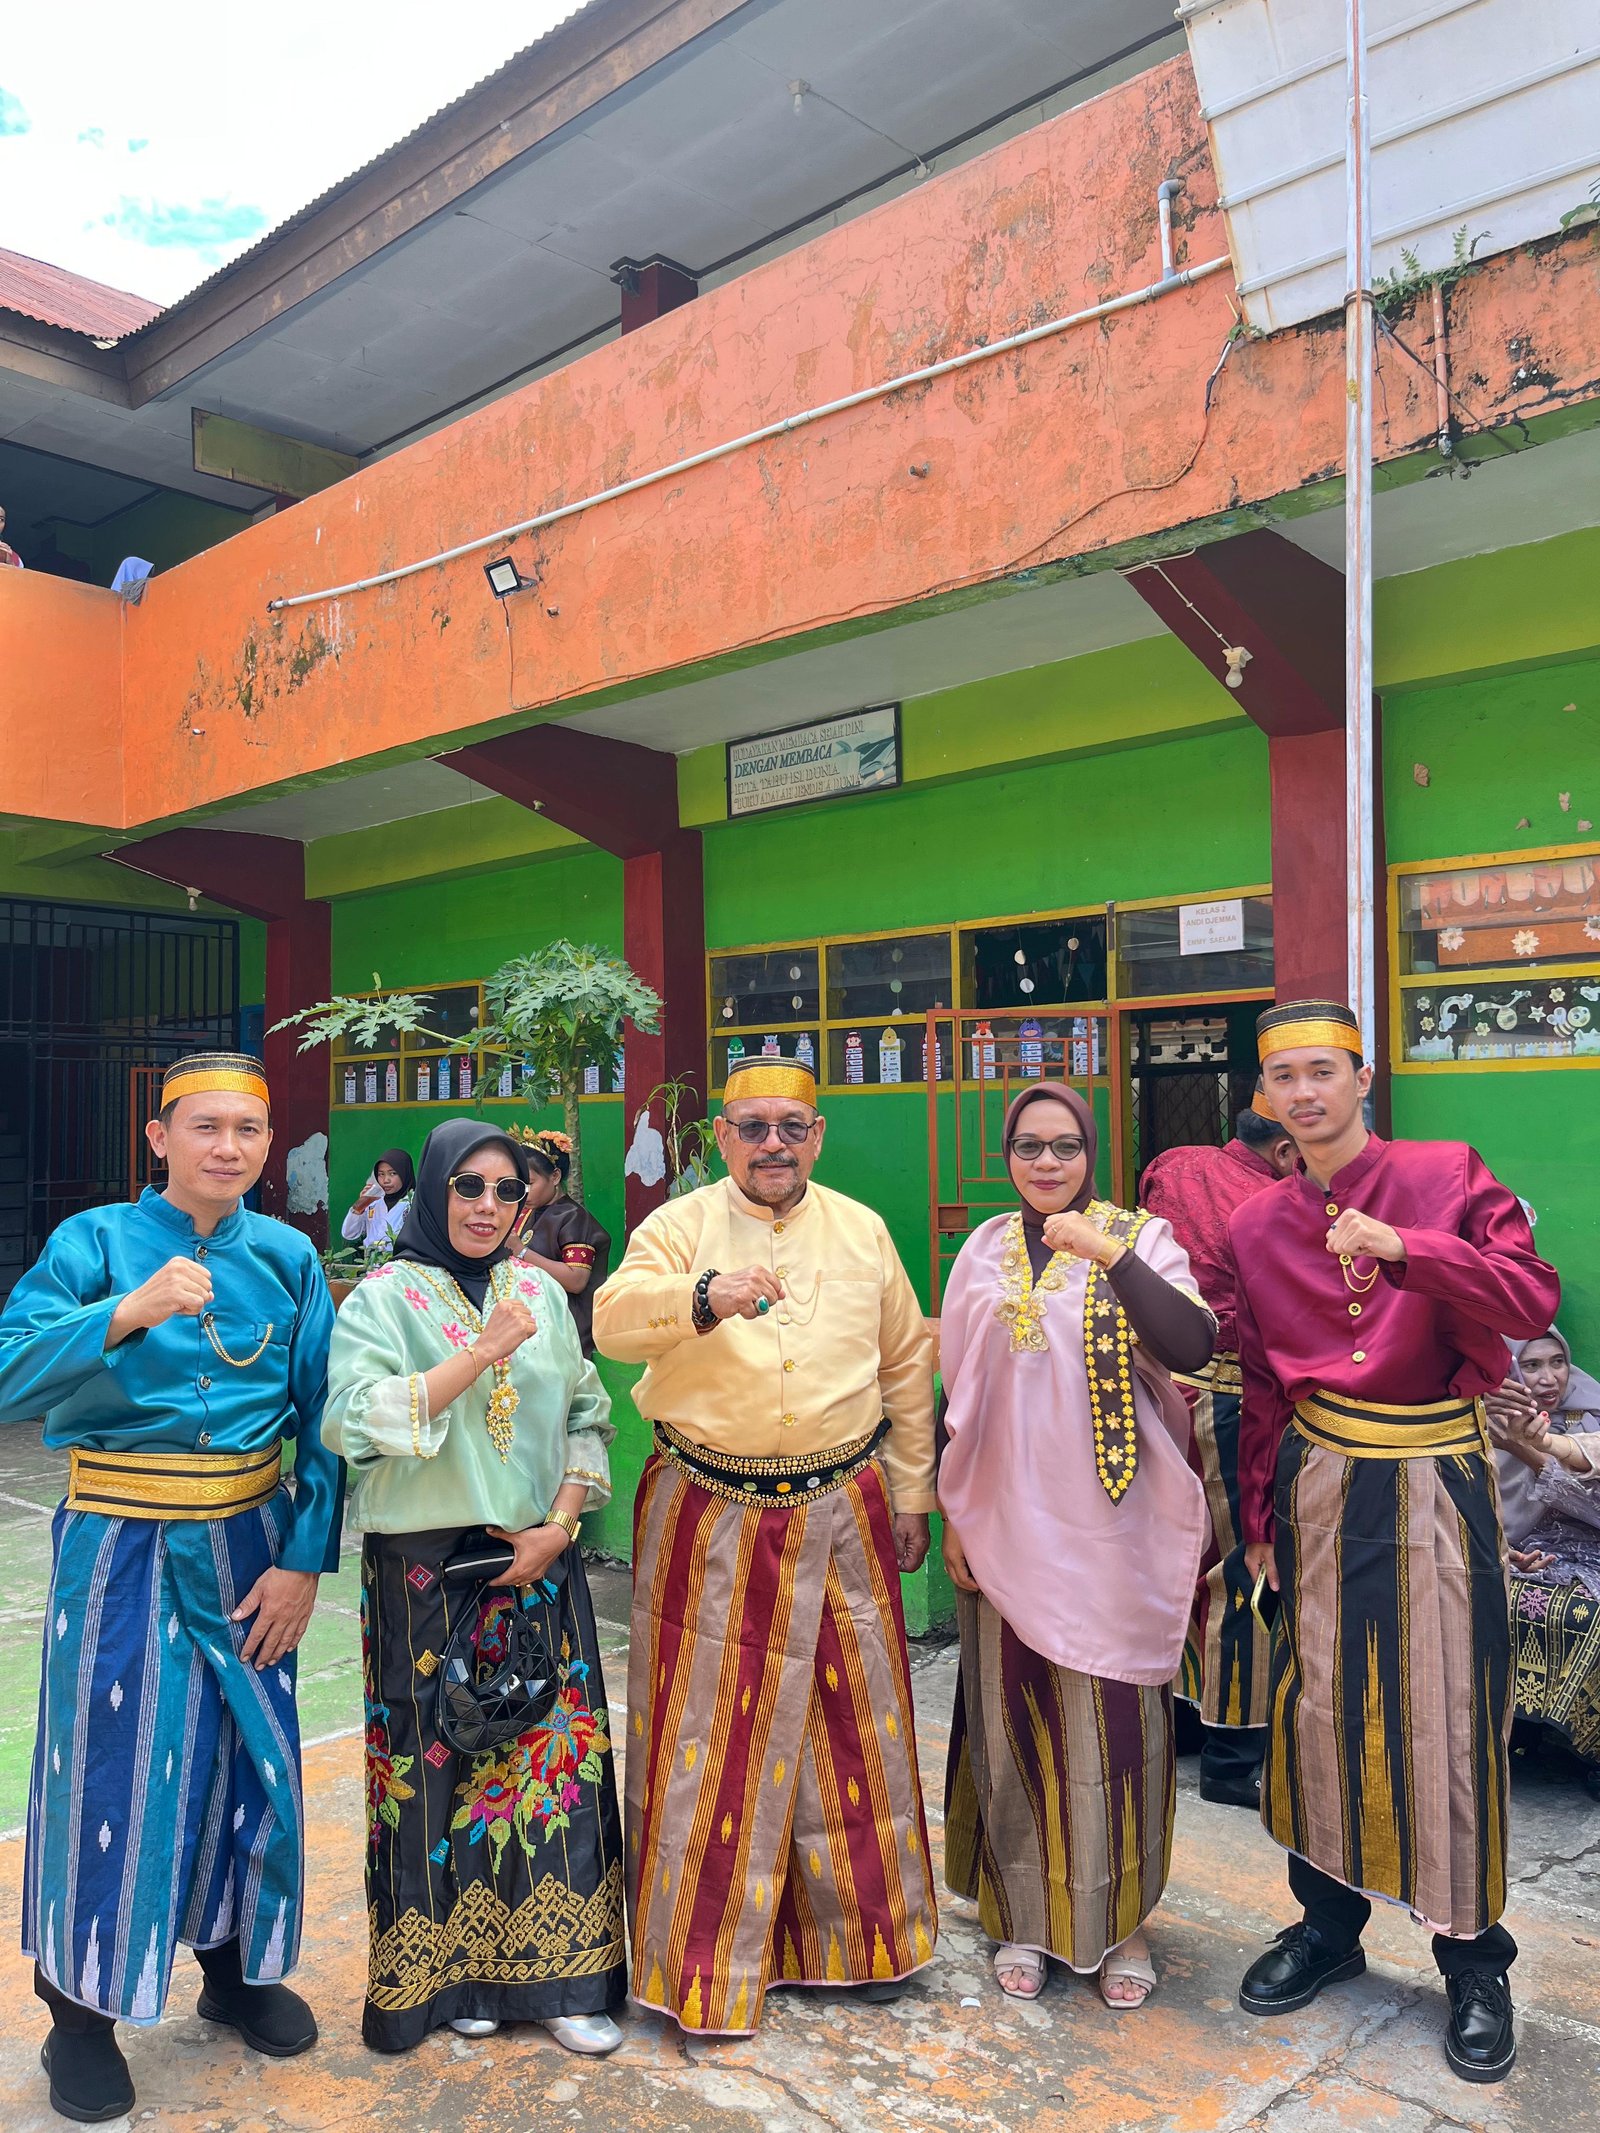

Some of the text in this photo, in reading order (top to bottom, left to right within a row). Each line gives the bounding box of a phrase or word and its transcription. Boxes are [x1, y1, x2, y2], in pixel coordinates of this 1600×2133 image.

[778, 734, 818, 752] MEMBACA
[845, 719, 865, 736] DINI
[734, 743, 832, 778] DENGAN MEMBACA
[790, 771, 805, 784] ISI
[807, 764, 840, 781] DUNIA
[1185, 914, 1237, 927] ANDI DJEMMA
[1195, 907, 1220, 916] KELAS
